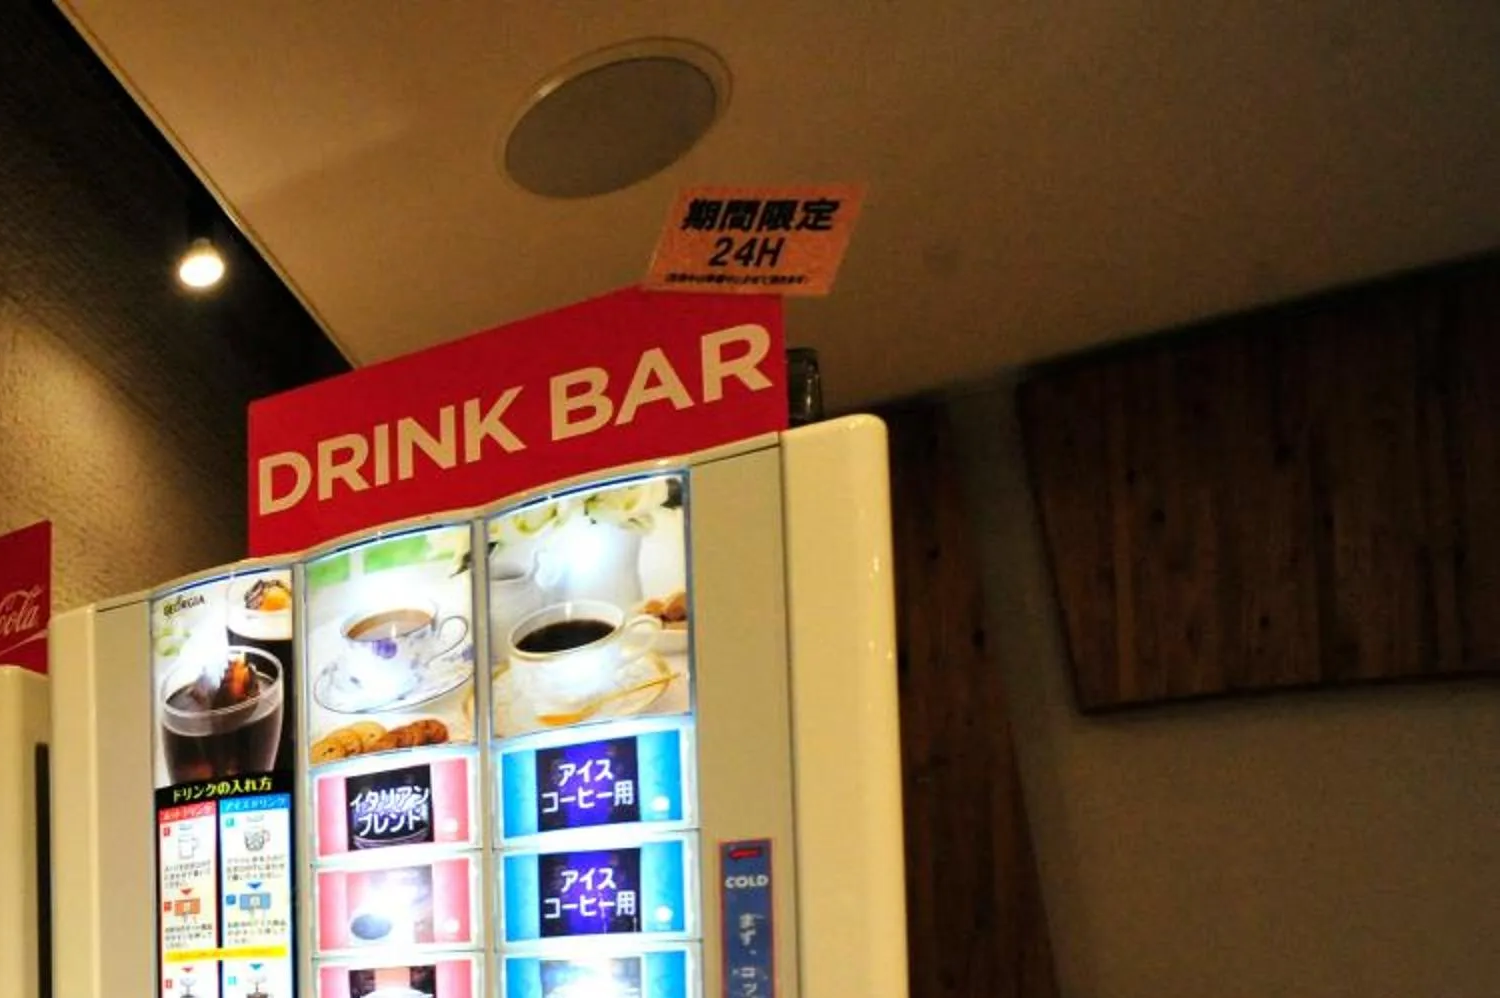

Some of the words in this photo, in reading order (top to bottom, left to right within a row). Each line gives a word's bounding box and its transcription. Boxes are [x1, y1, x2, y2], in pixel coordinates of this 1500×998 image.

[680, 198, 842, 232] 期間限定
[709, 236, 786, 268] 24H
[258, 385, 527, 516] DRINK
[550, 322, 774, 442] BAR
[558, 758, 614, 787] アイス
[173, 776, 272, 803] ドリンクの入れ方
[541, 780, 634, 814] コーヒー用
[560, 866, 617, 894] アイス
[725, 874, 769, 889] COLD
[544, 890, 637, 920] コーヒー用
